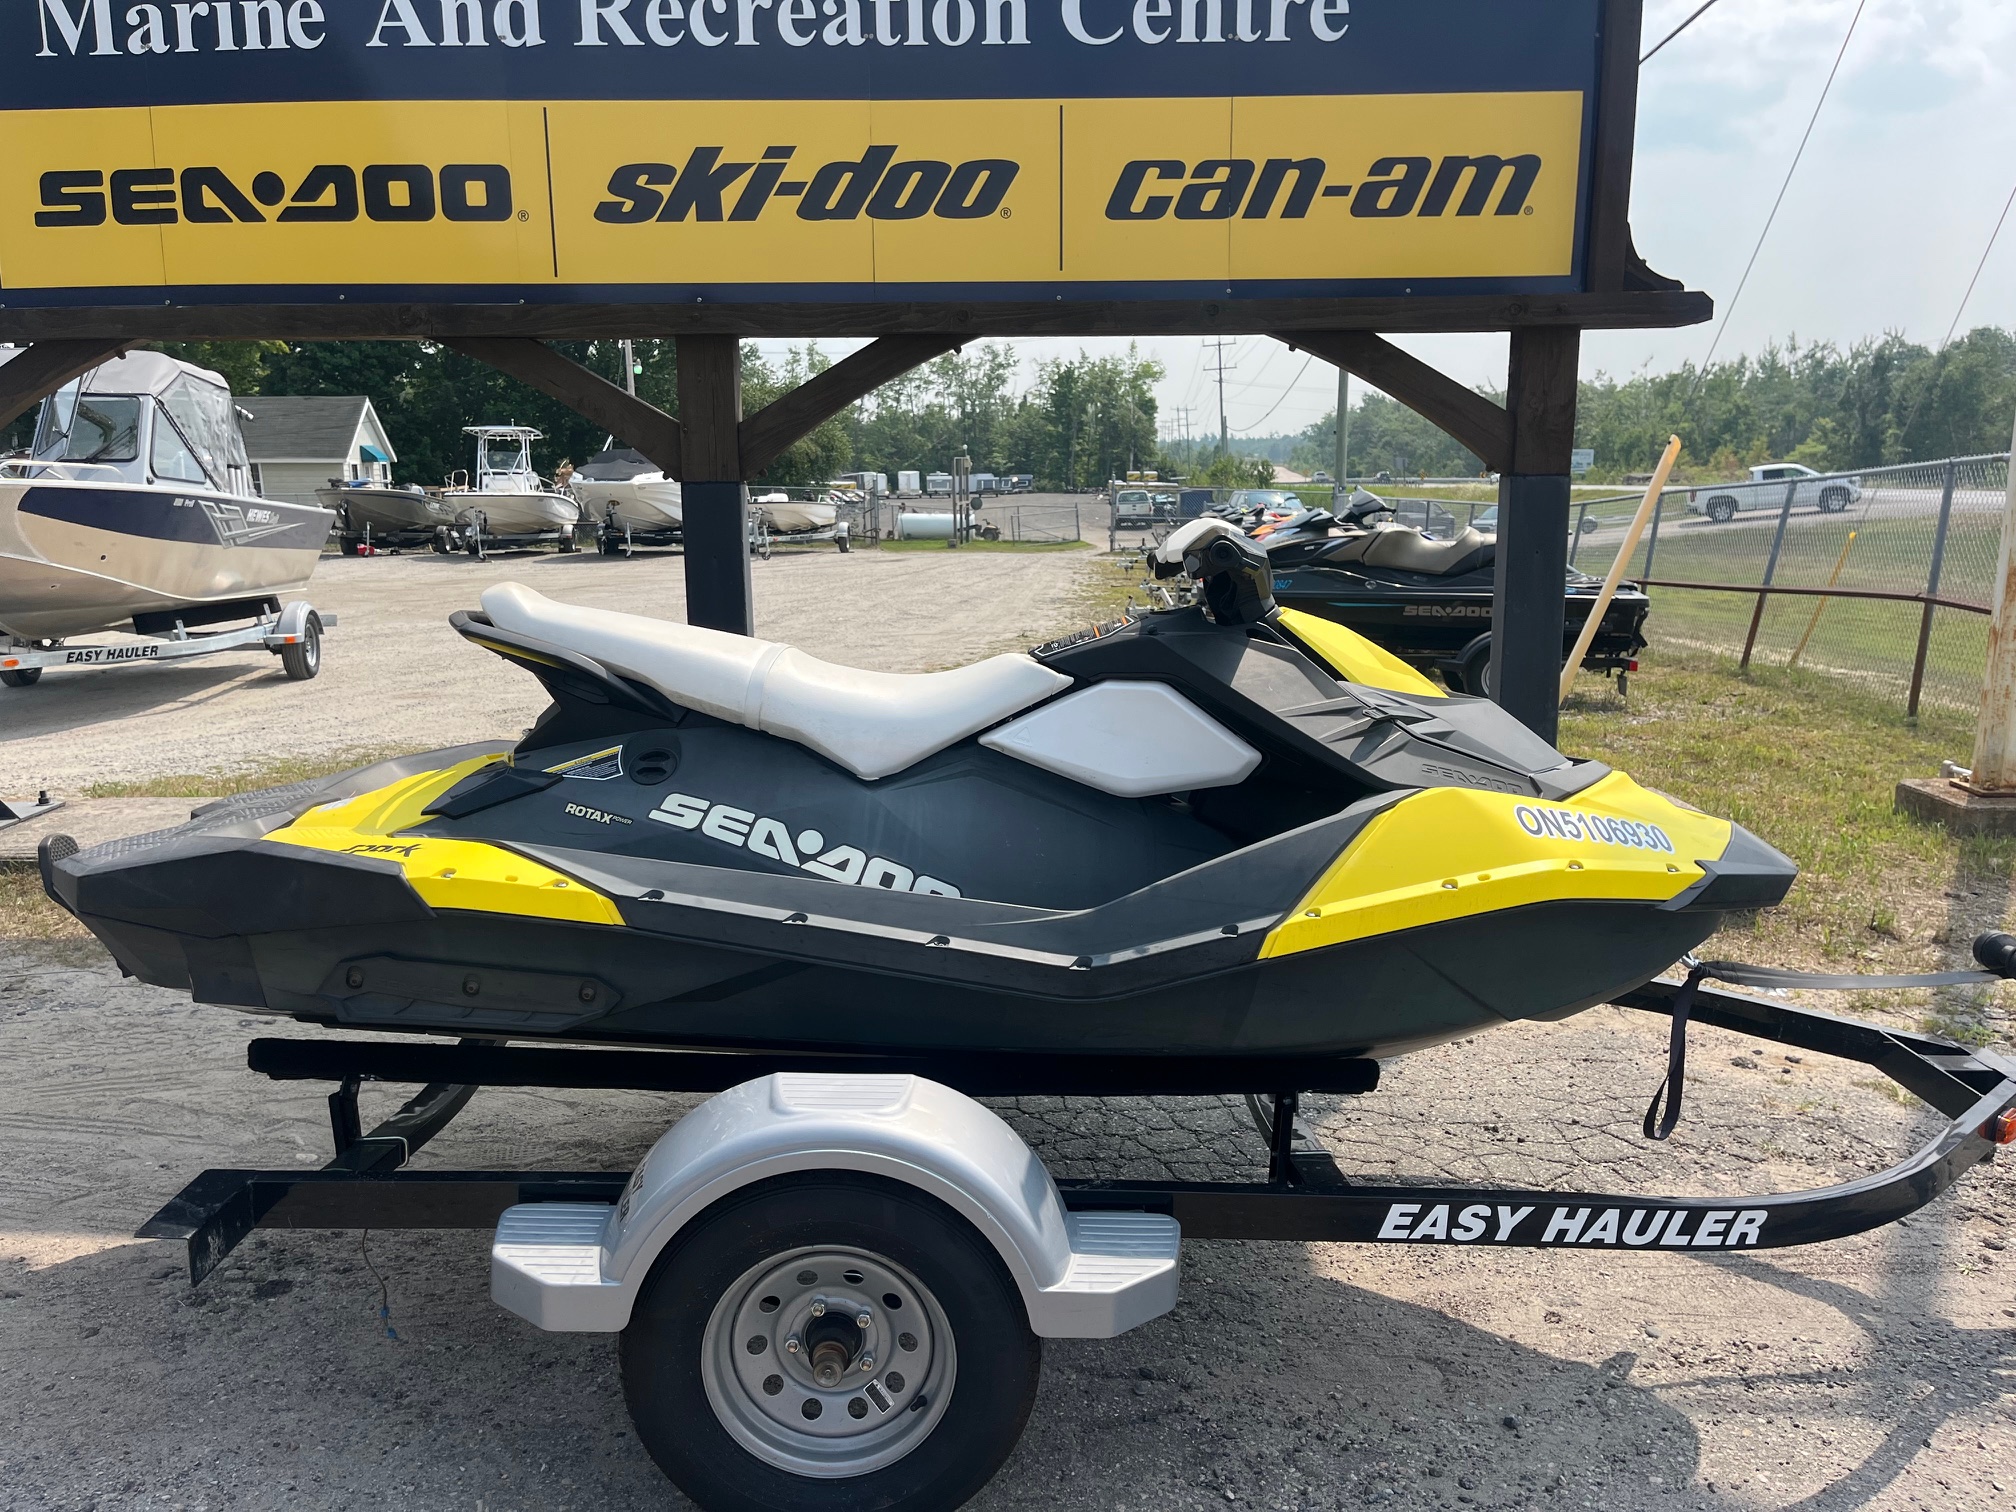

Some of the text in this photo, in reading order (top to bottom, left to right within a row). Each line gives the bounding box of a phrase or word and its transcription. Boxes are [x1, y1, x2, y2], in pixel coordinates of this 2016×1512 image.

[36, 0, 1350, 57] Marine And Recreation Centre
[66, 645, 159, 664] EASY HAULER
[564, 802, 633, 826] ROTAX POWER
[1515, 804, 1675, 855] ON5106930
[1377, 1203, 1769, 1247] EASY HAULER
